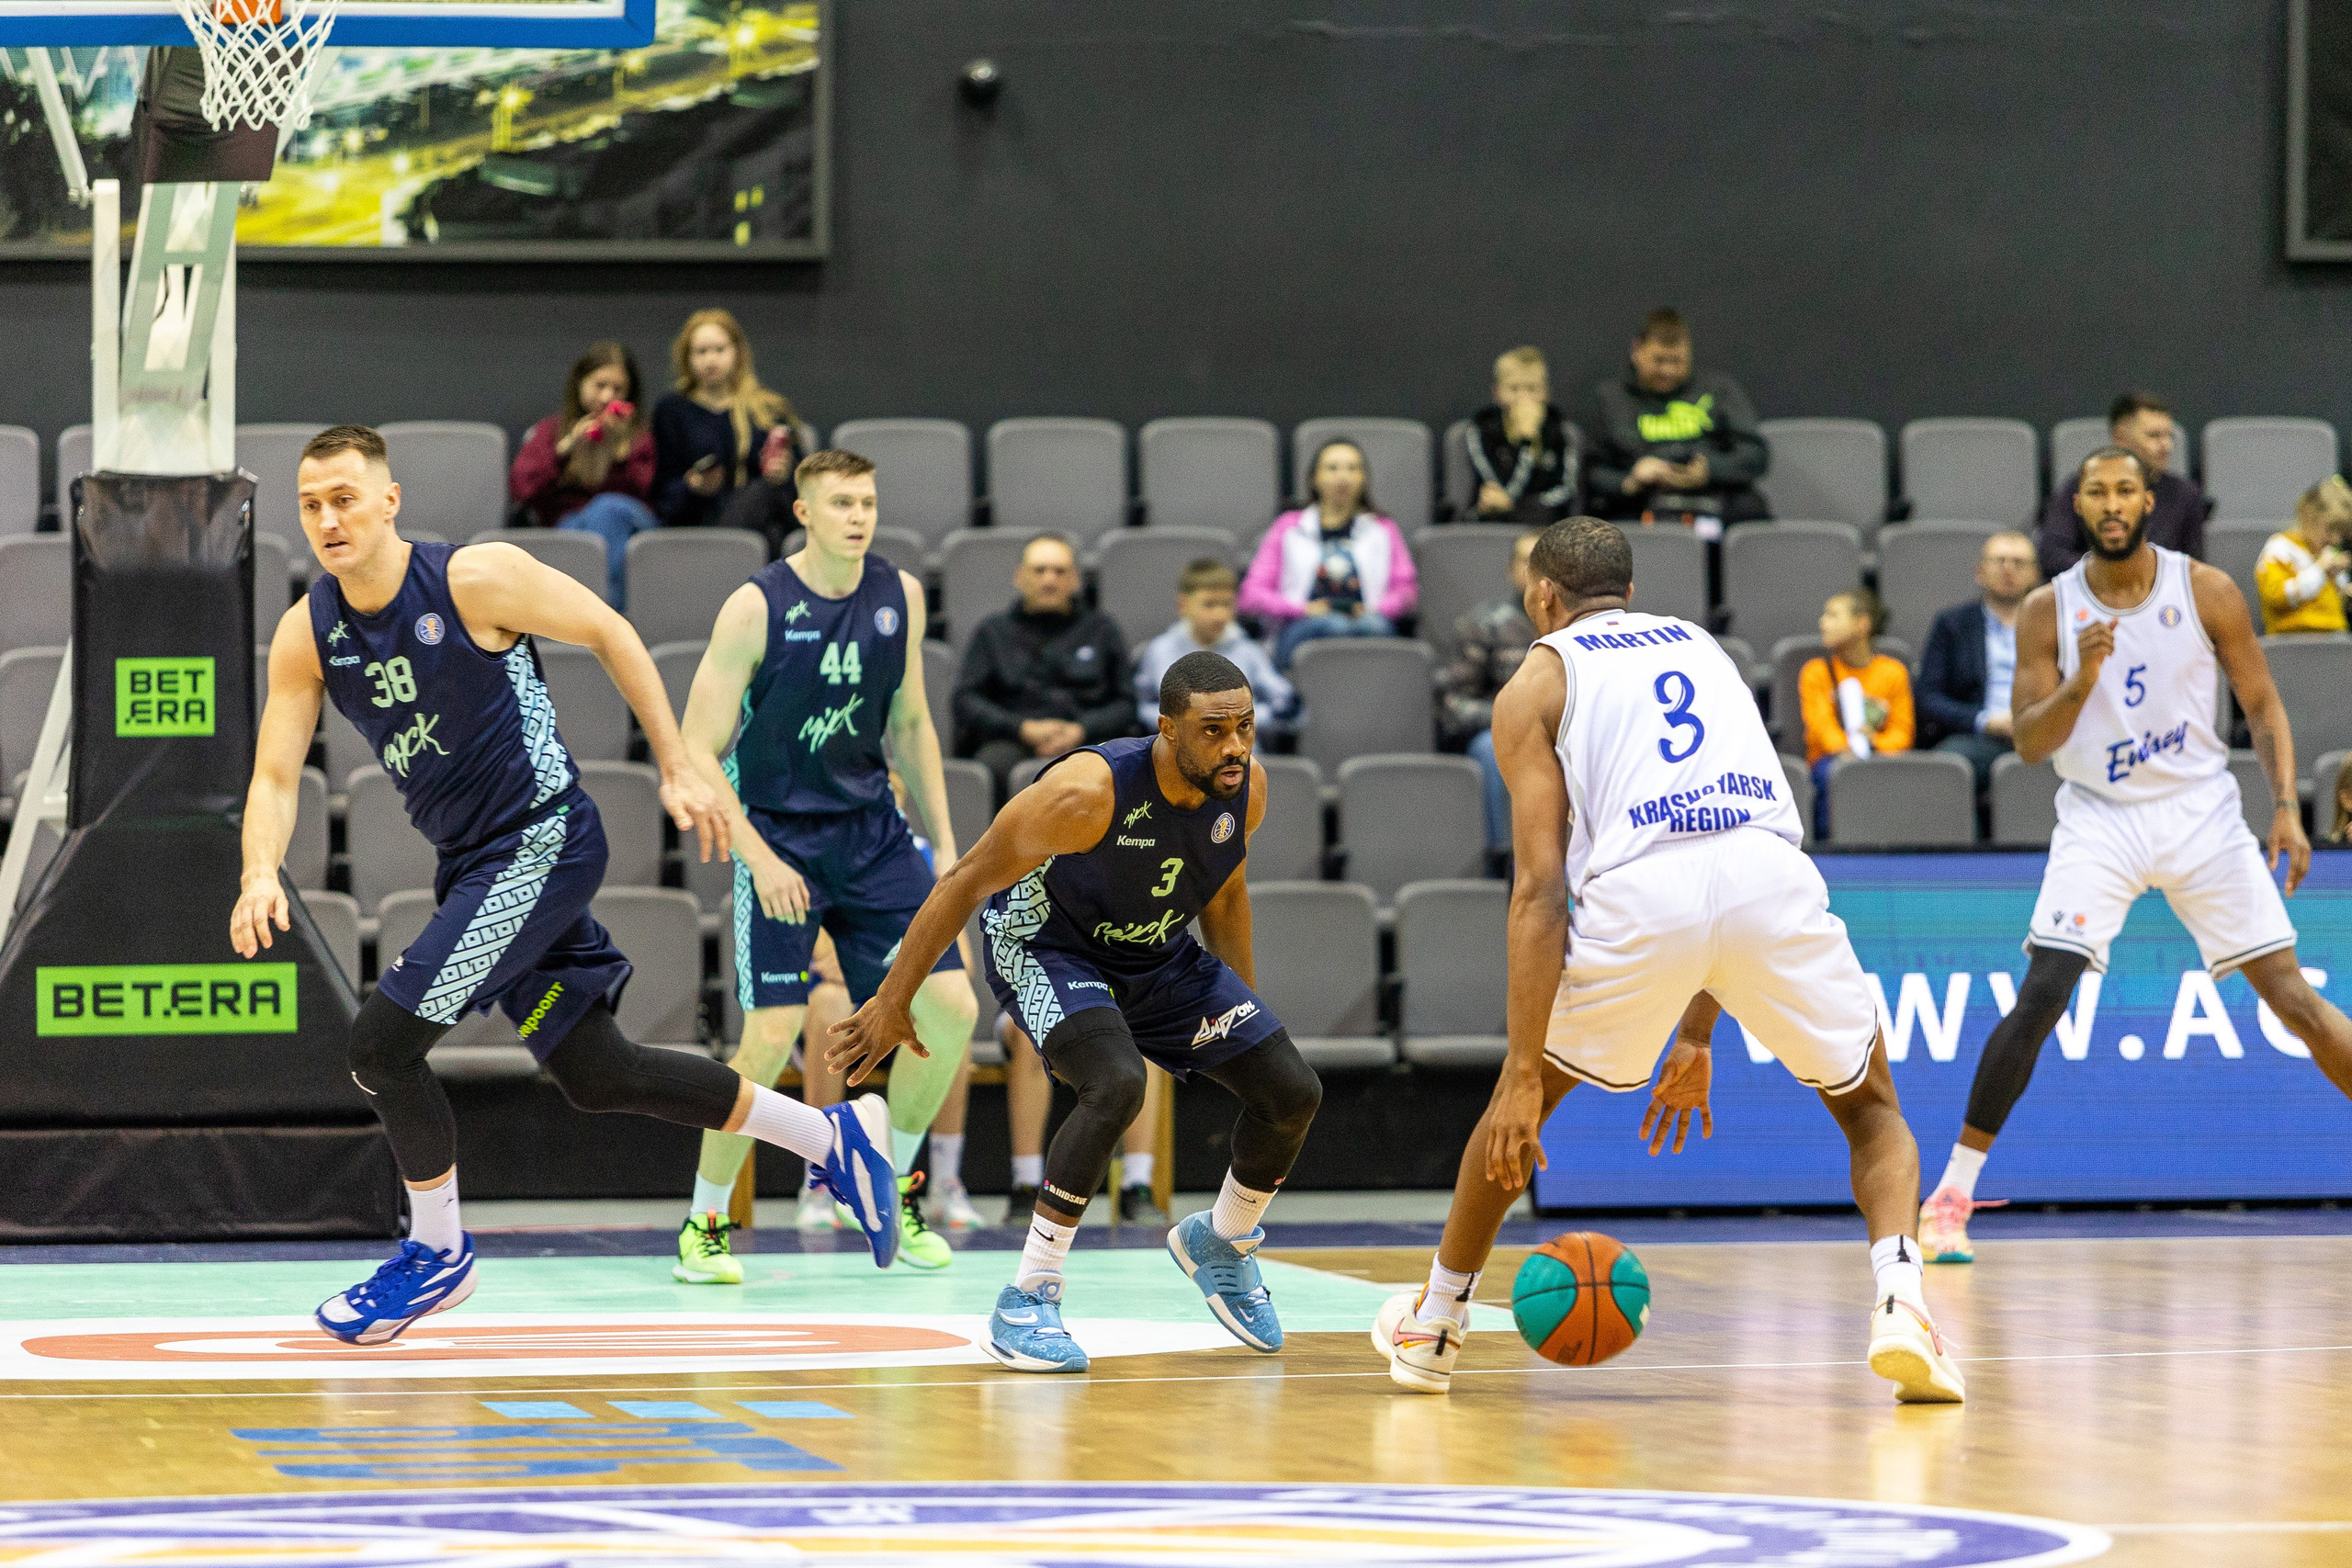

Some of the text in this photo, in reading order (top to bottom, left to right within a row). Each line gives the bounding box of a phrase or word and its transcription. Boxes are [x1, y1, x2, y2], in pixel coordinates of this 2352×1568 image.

[785, 629, 821, 642] Kempa
[1573, 625, 1692, 651] MARTIN
[820, 641, 863, 684] 44
[130, 670, 206, 694] BET
[365, 656, 417, 708] 38
[2124, 662, 2146, 707] 5
[1654, 671, 1705, 763] 3
[1669, 807, 1751, 832] REGION
[1116, 835, 1156, 849] Kempa
[1151, 858, 1184, 897] 3
[761, 971, 799, 985] Kempa
[1068, 981, 1108, 991] Kempa
[52, 981, 281, 1019] BET.ERA
